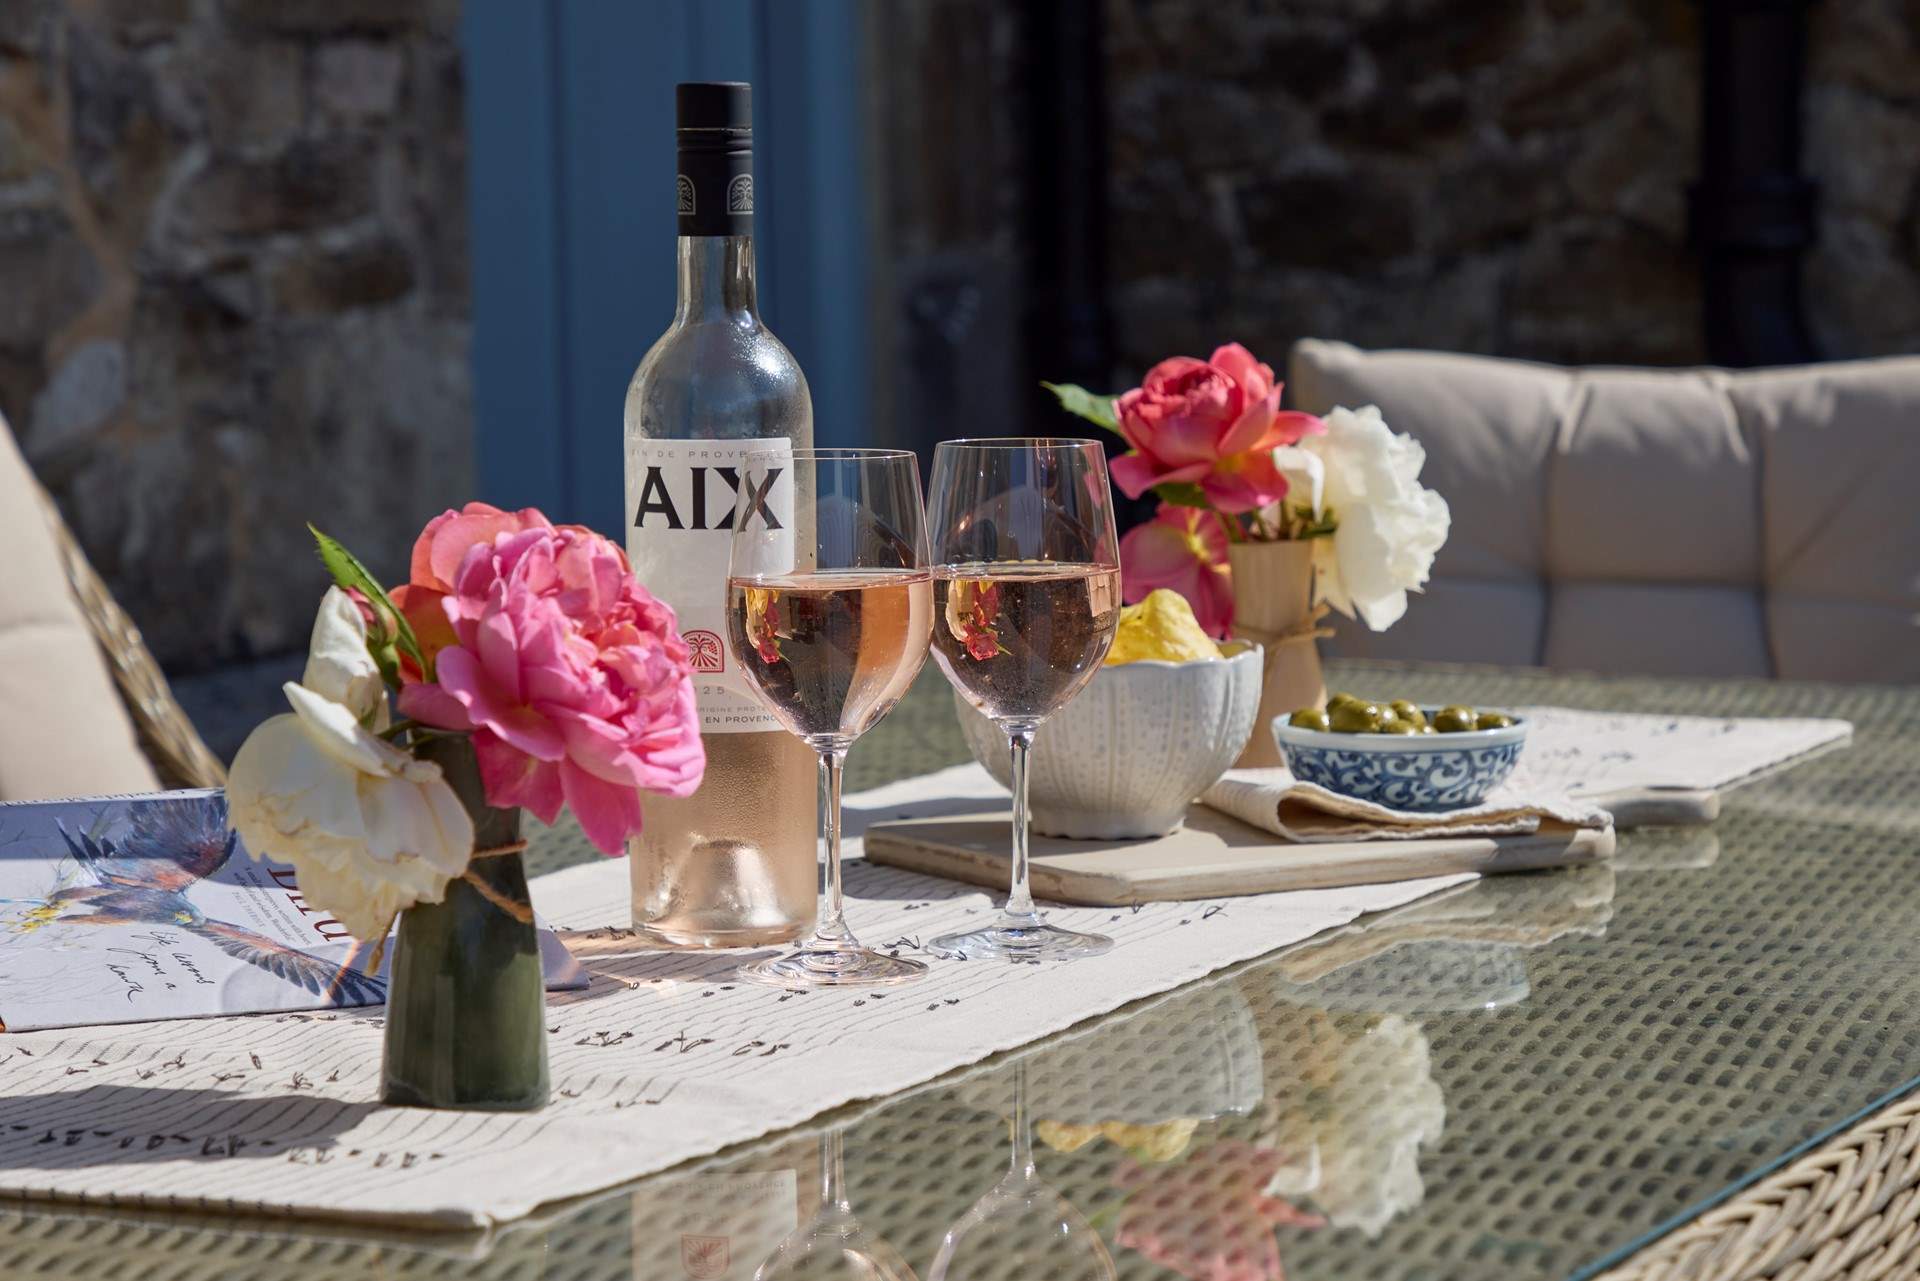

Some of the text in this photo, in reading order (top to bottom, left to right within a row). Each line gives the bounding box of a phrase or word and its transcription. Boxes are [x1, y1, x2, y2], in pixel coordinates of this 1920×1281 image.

[657, 450, 675, 458] DE
[634, 466, 784, 532] AIX
[705, 714, 777, 724] EN PROVENC
